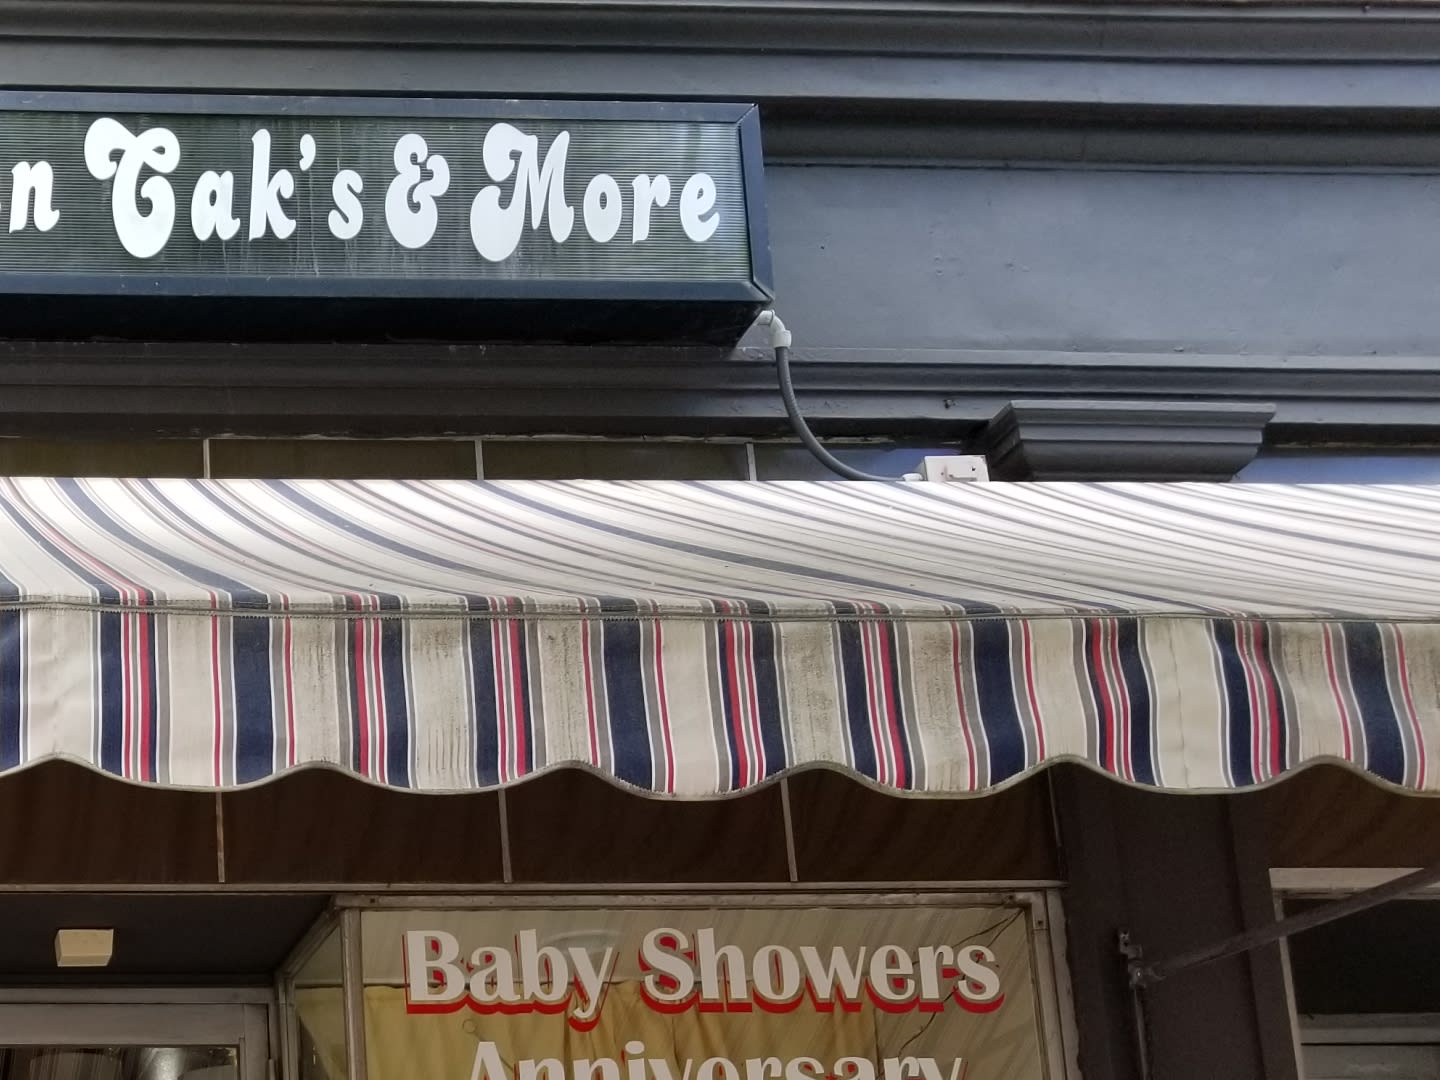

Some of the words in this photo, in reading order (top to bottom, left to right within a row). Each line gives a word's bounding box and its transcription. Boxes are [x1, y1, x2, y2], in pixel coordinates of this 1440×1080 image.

[385, 133, 449, 248] &
[470, 123, 719, 262] More
[402, 929, 620, 1032] Baby
[638, 928, 1004, 1014] Showers
